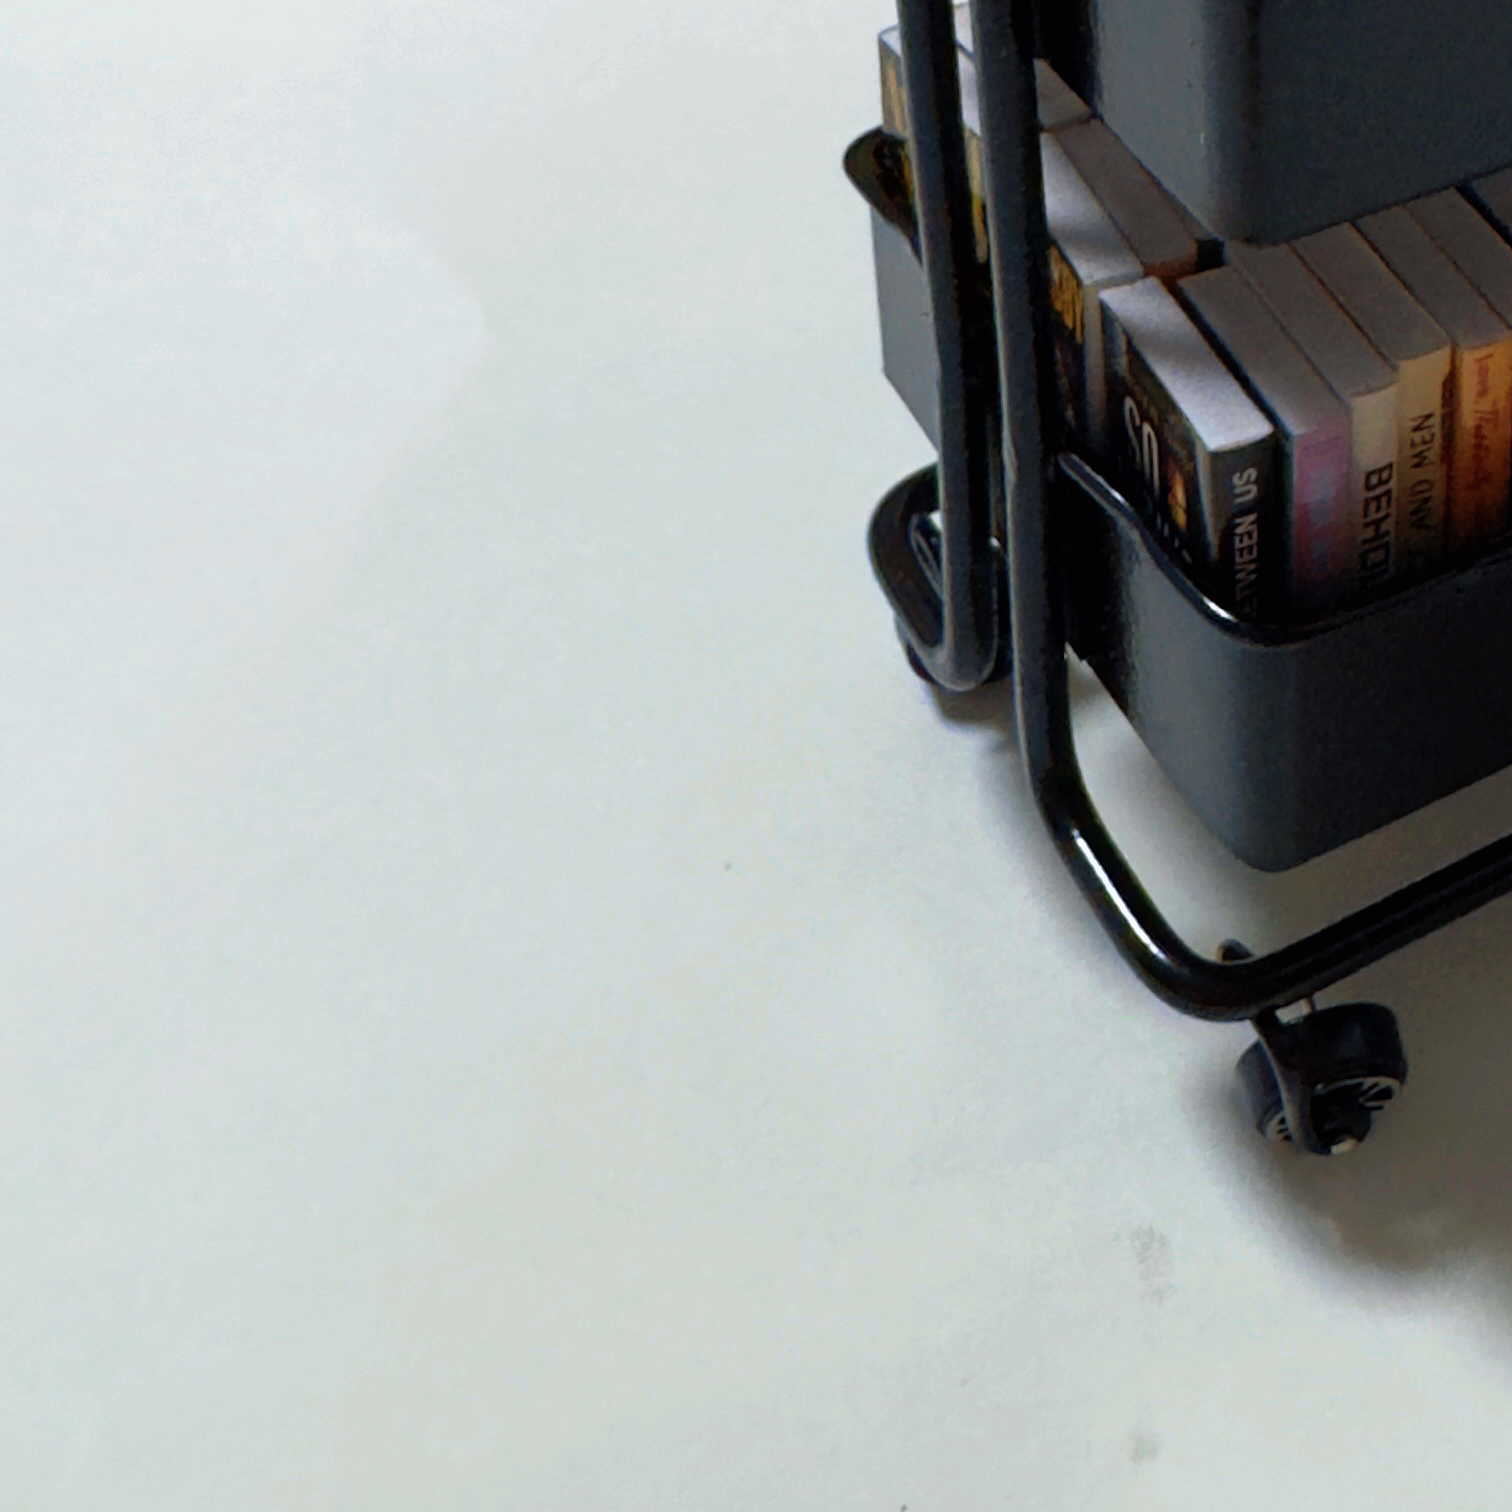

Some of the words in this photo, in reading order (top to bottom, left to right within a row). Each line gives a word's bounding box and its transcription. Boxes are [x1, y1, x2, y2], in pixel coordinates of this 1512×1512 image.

[1410, 412, 1436, 470] MEN
[1230, 467, 1260, 505] US
[1408, 479, 1434, 532] AND
